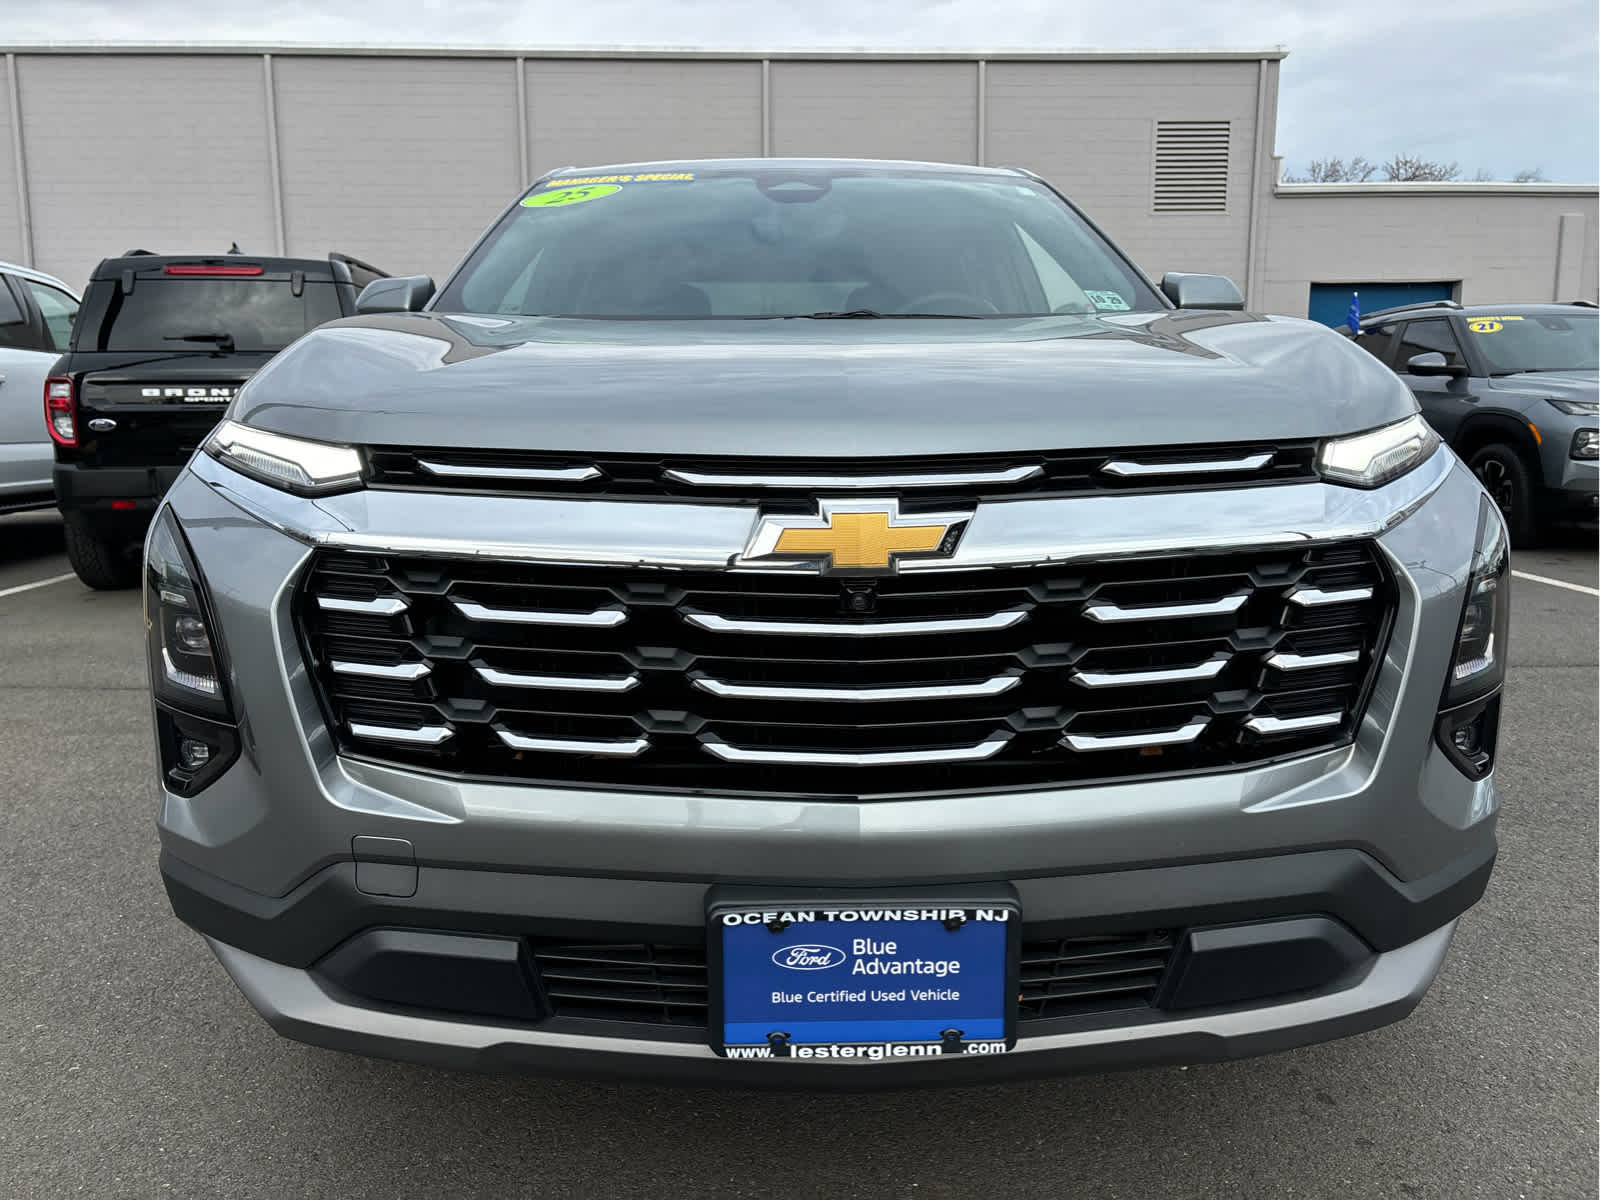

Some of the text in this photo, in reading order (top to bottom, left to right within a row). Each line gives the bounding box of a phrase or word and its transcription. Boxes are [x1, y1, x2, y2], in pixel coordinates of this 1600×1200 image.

[1478, 322, 1494, 330] 21
[141, 388, 238, 397] BRON
[722, 911, 815, 926] OCEAN
[975, 909, 1009, 922] NJ
[852, 938, 897, 956] Blue
[785, 946, 832, 967] Ford
[852, 958, 961, 978] Advantage
[771, 988, 960, 1004] Blue Certified Used Vehicle
[789, 1042, 943, 1060] lesterglenn
